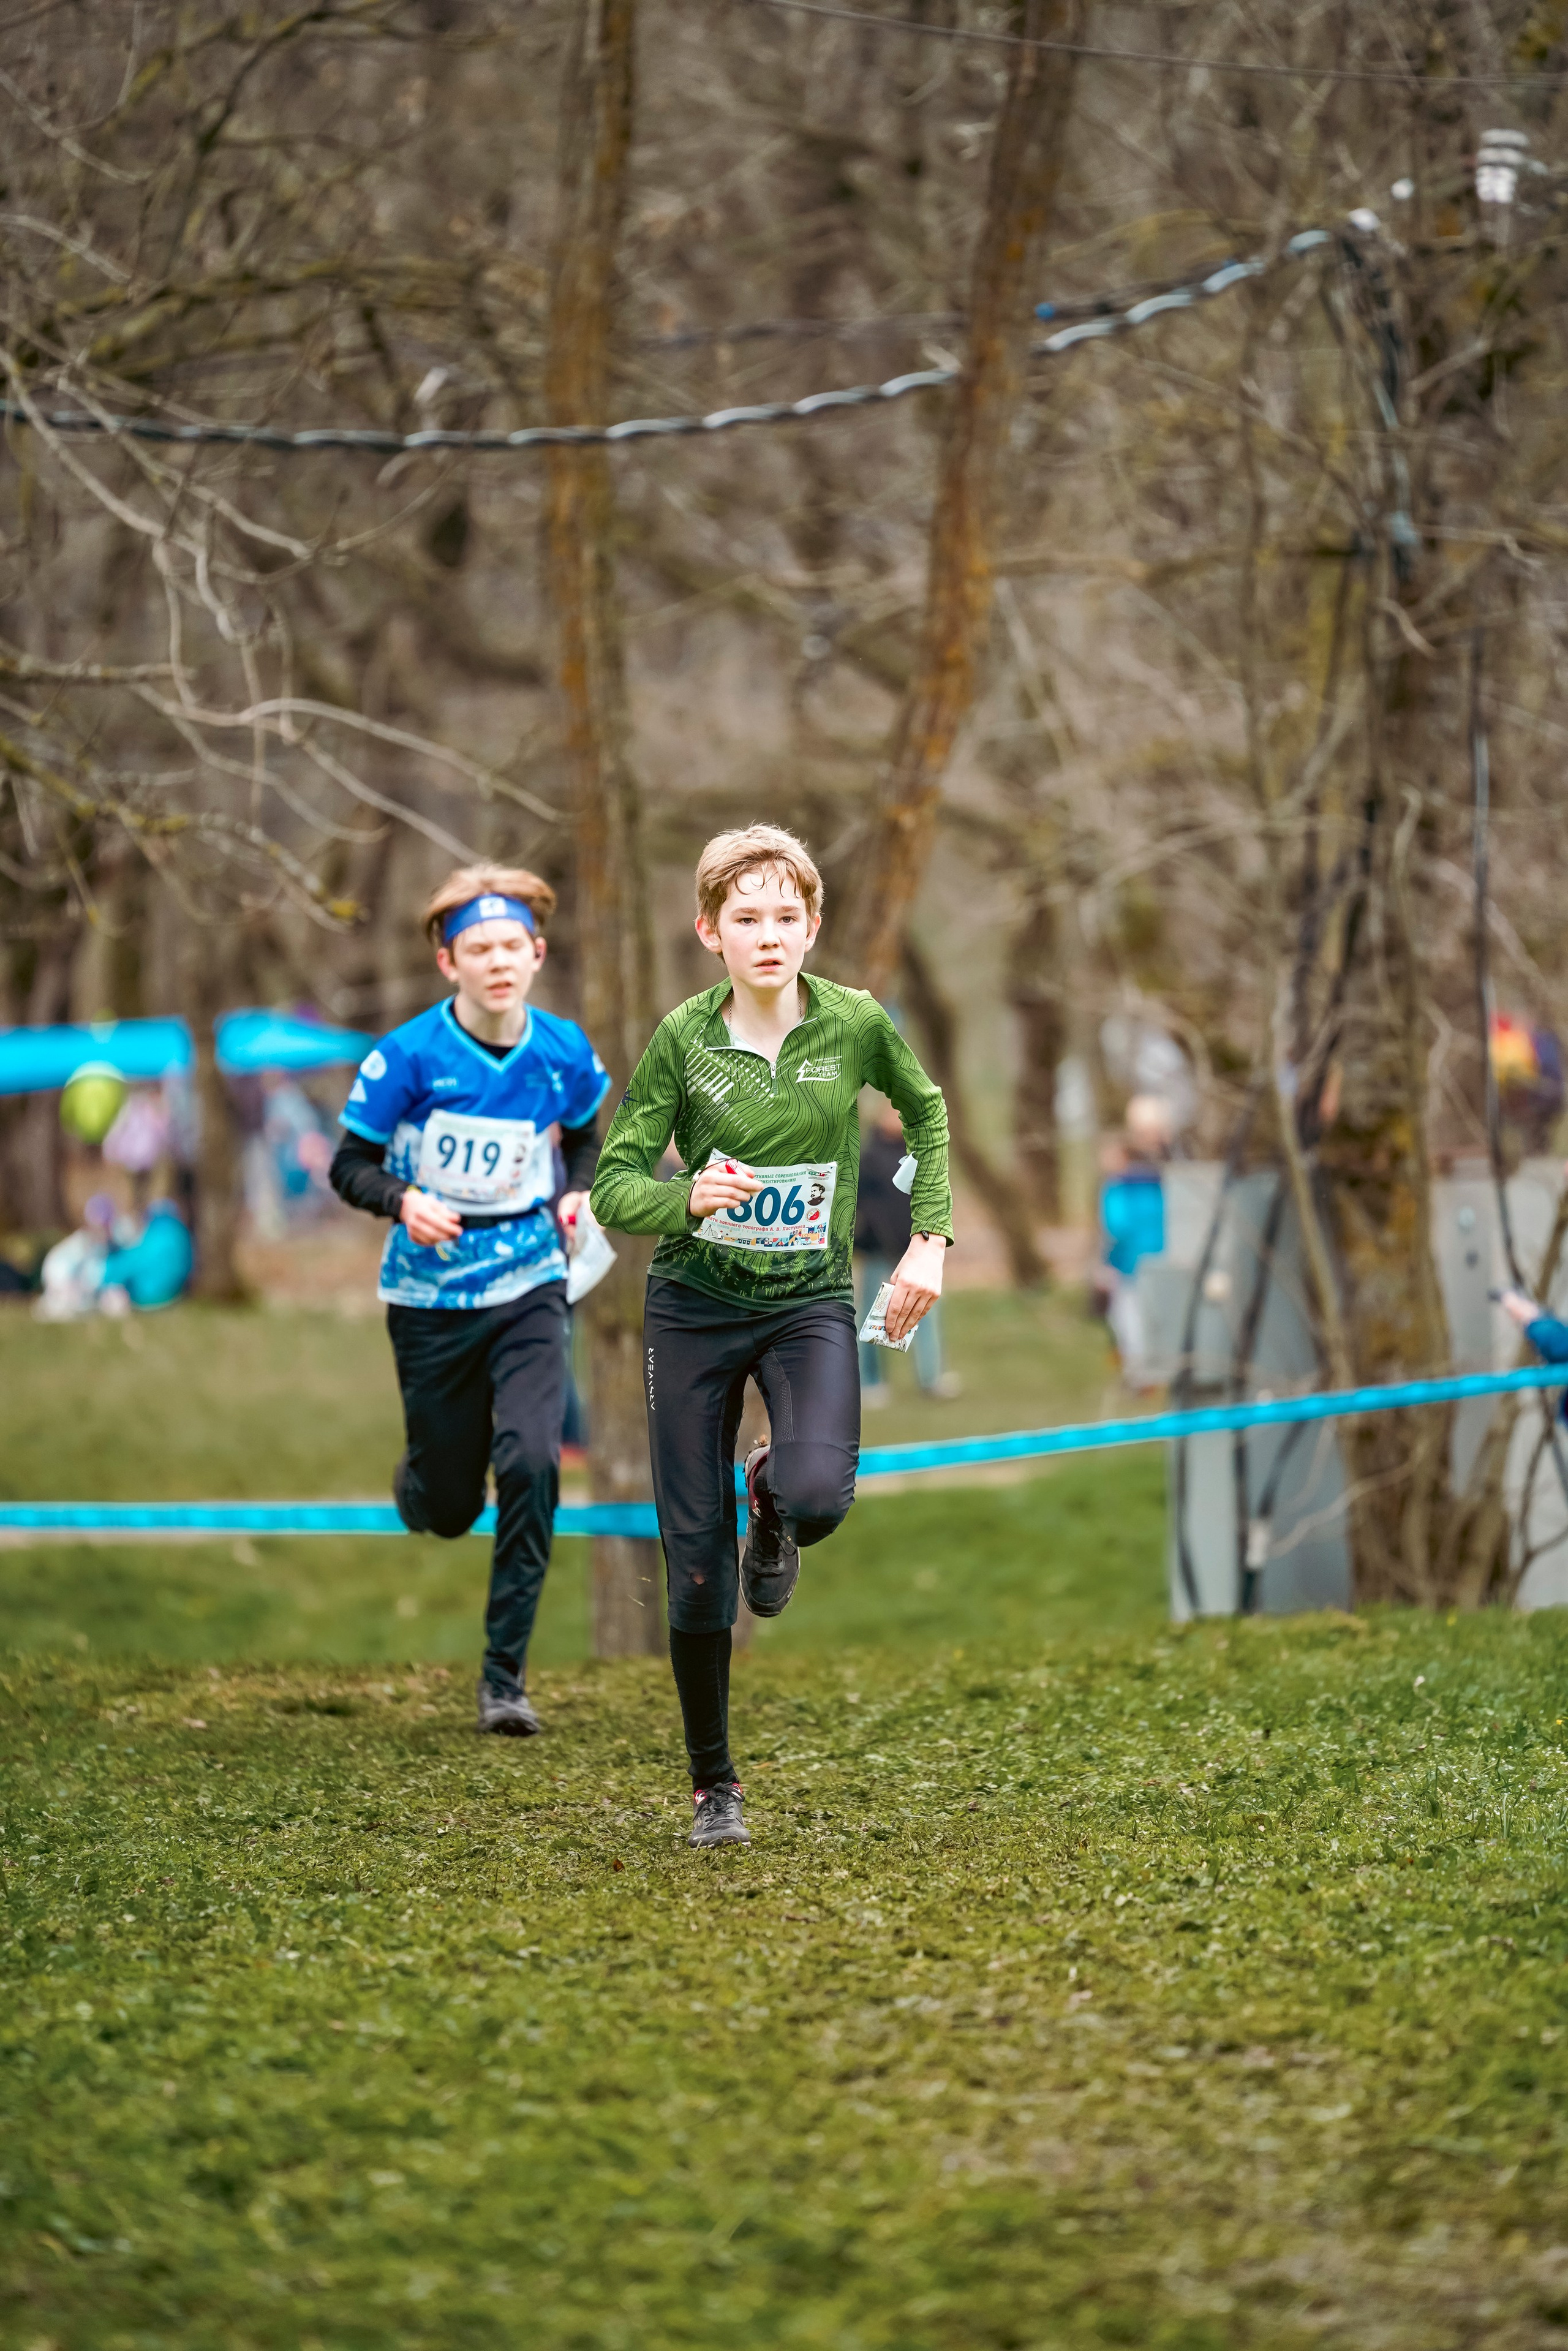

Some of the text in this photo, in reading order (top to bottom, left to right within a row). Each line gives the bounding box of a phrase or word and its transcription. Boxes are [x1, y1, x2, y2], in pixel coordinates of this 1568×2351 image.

[805, 1063, 842, 1073] FOREST
[437, 1134, 501, 1176] 919
[719, 1220, 741, 1228] военного
